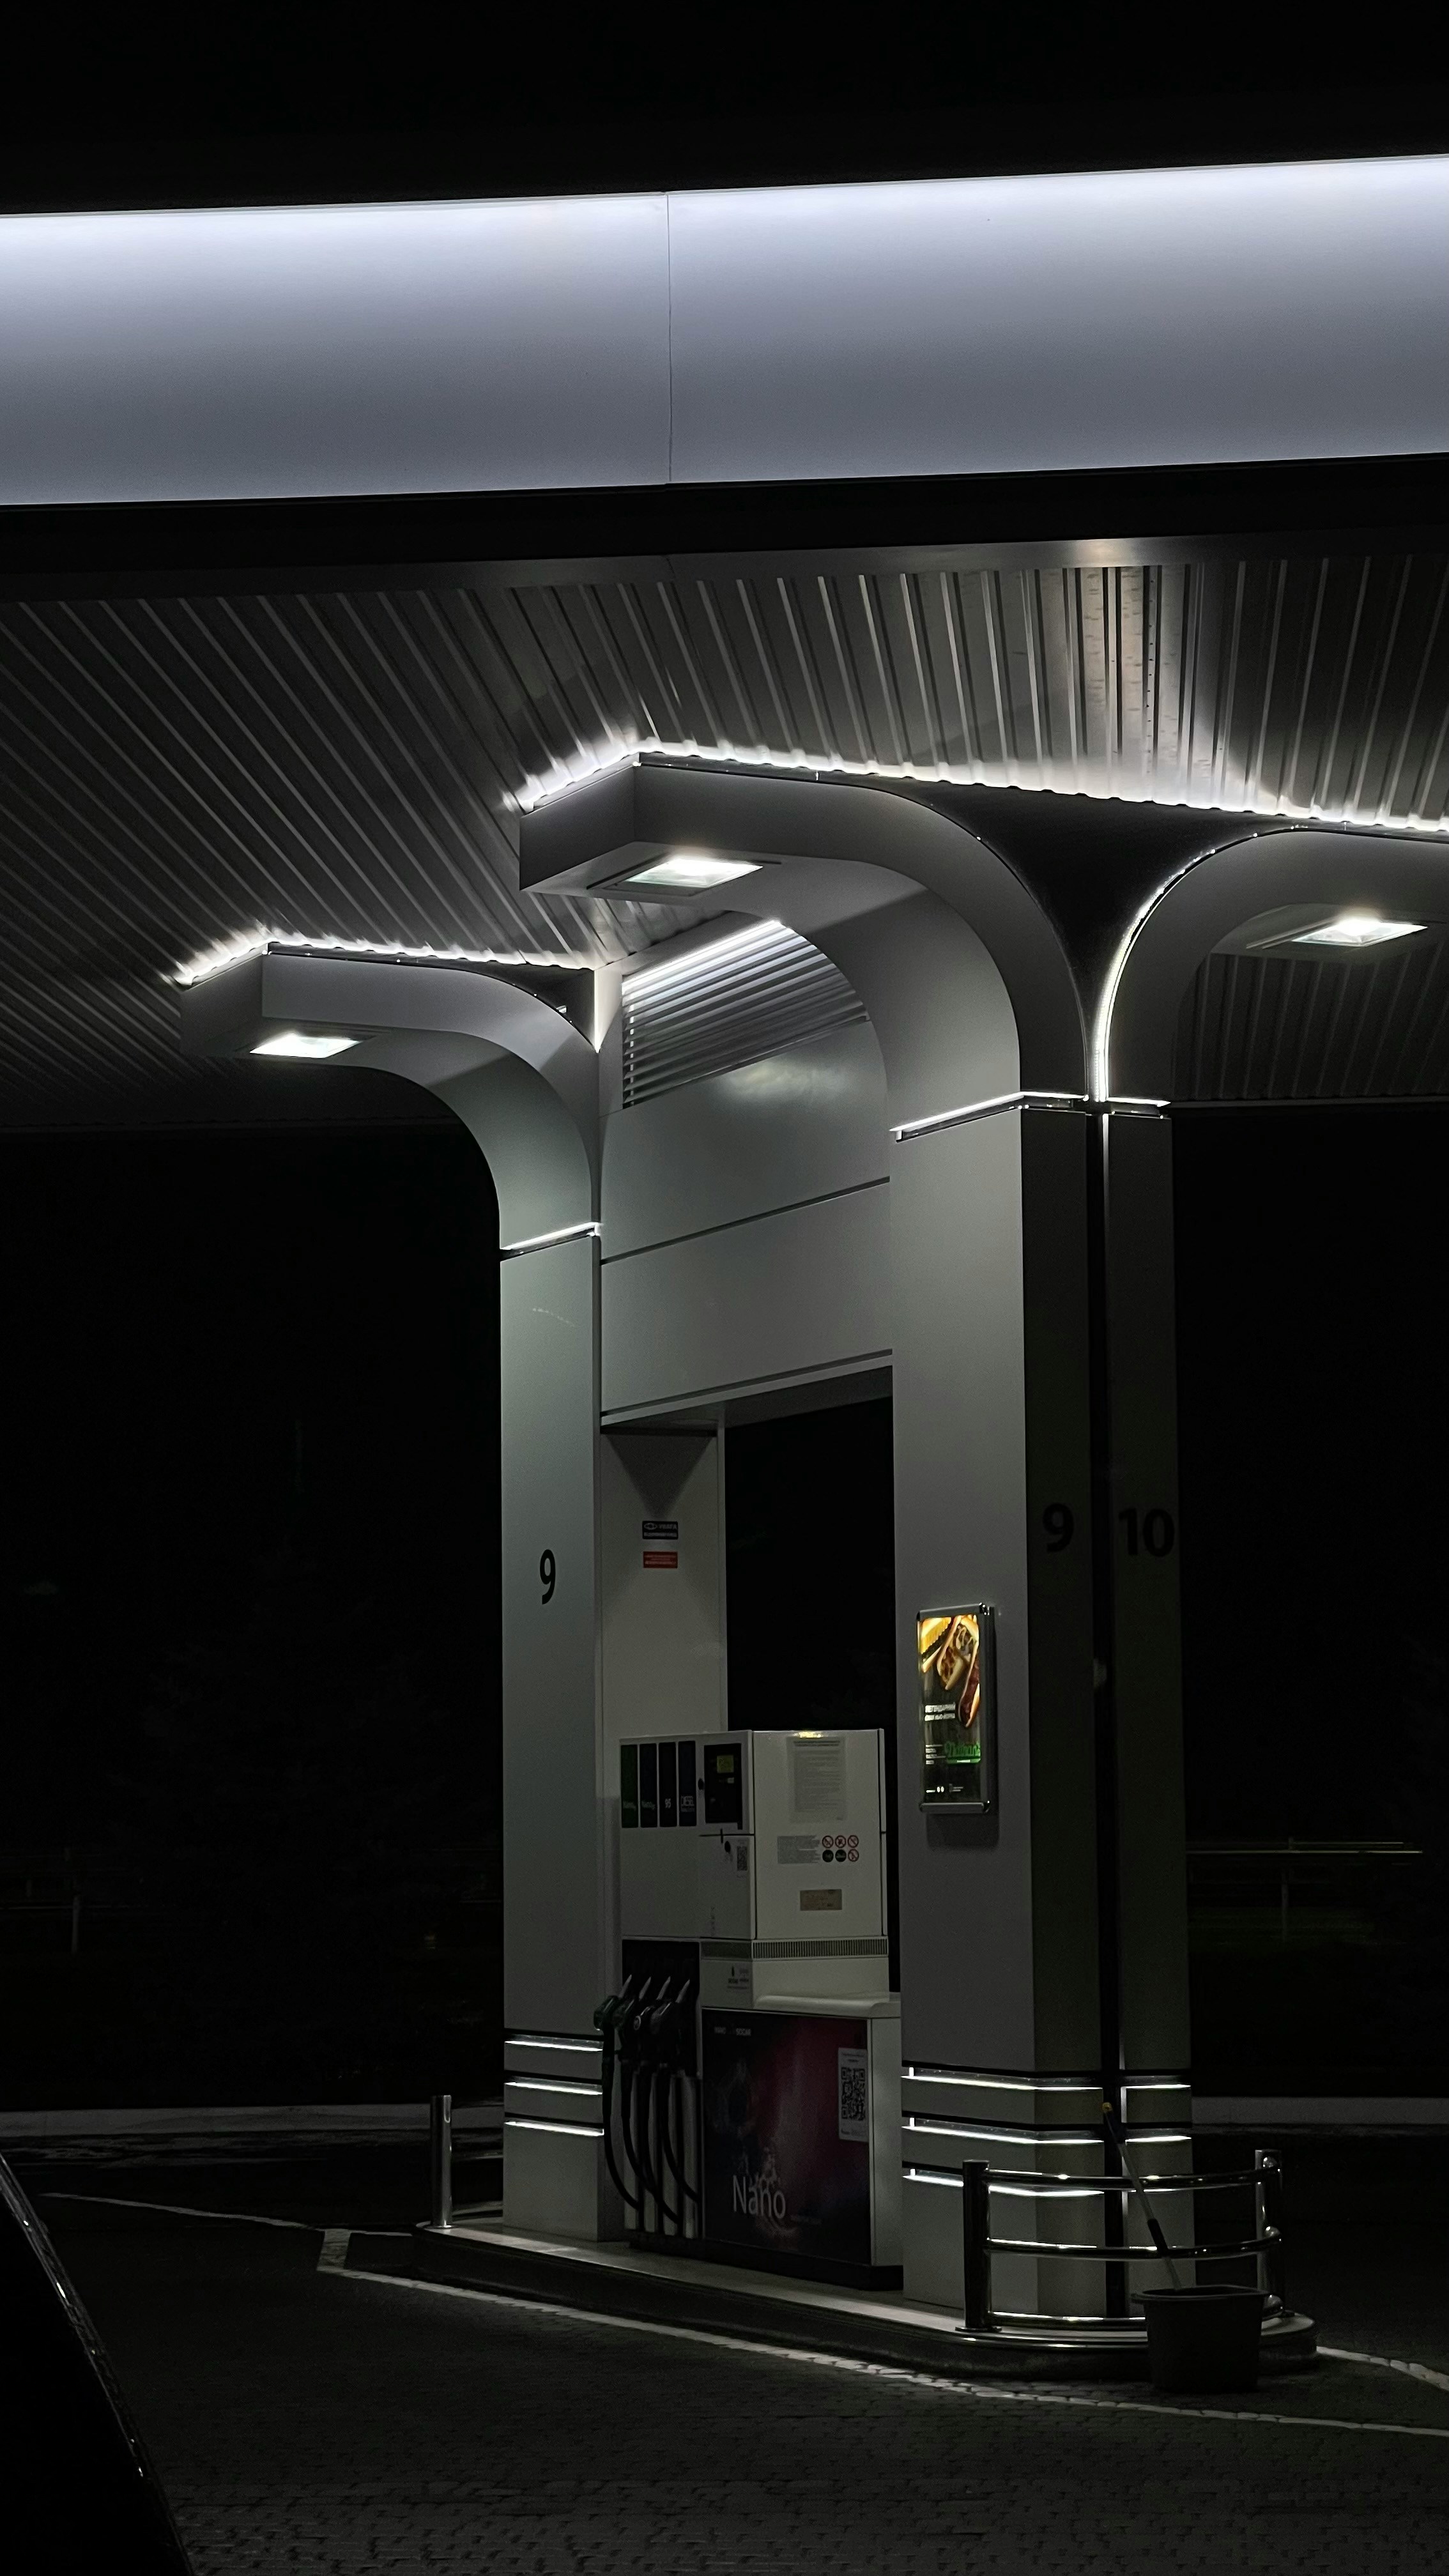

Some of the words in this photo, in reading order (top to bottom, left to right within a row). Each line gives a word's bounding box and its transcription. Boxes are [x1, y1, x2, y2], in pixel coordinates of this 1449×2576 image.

[1043, 1503, 1074, 1552] 9
[1119, 1508, 1175, 1556] 10
[540, 1549, 556, 1604] 9
[732, 2174, 786, 2219] Nano
